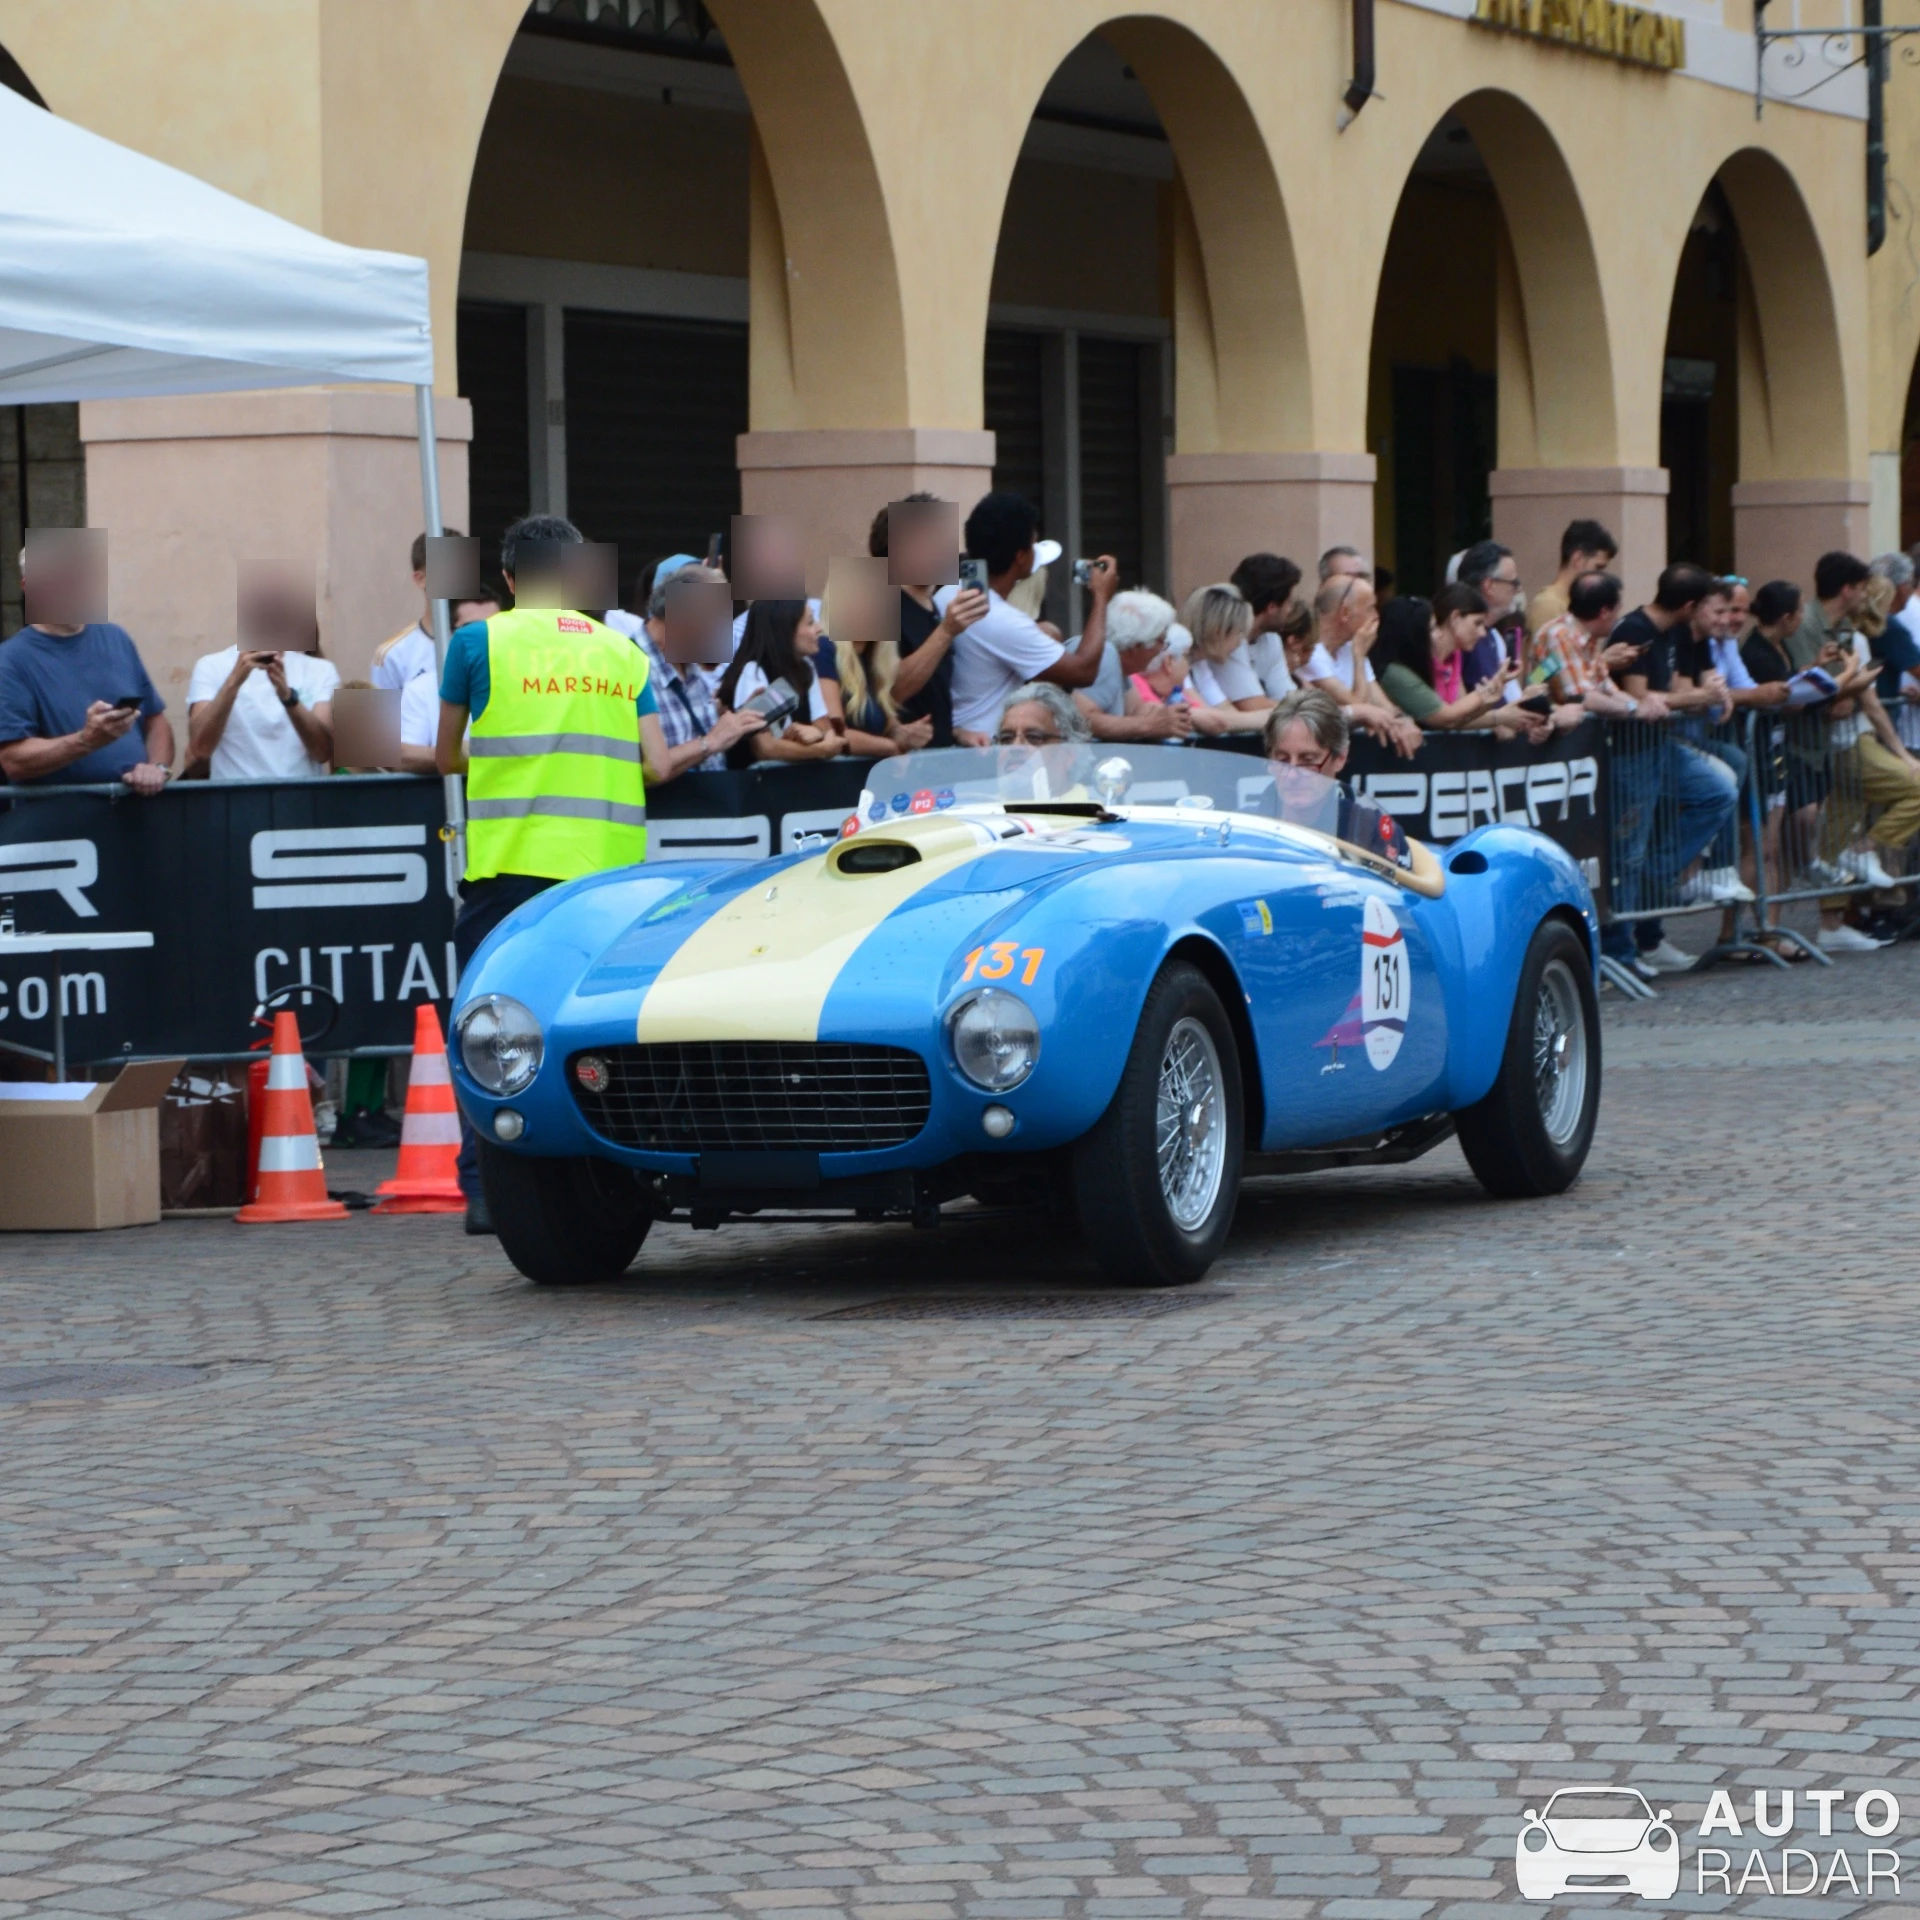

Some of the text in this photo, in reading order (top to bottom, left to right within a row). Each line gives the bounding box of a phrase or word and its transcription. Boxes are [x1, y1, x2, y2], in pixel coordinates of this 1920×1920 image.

[523, 676, 637, 701] MARSHAL
[962, 942, 1045, 985] 131
[1374, 954, 1399, 1010] 131
